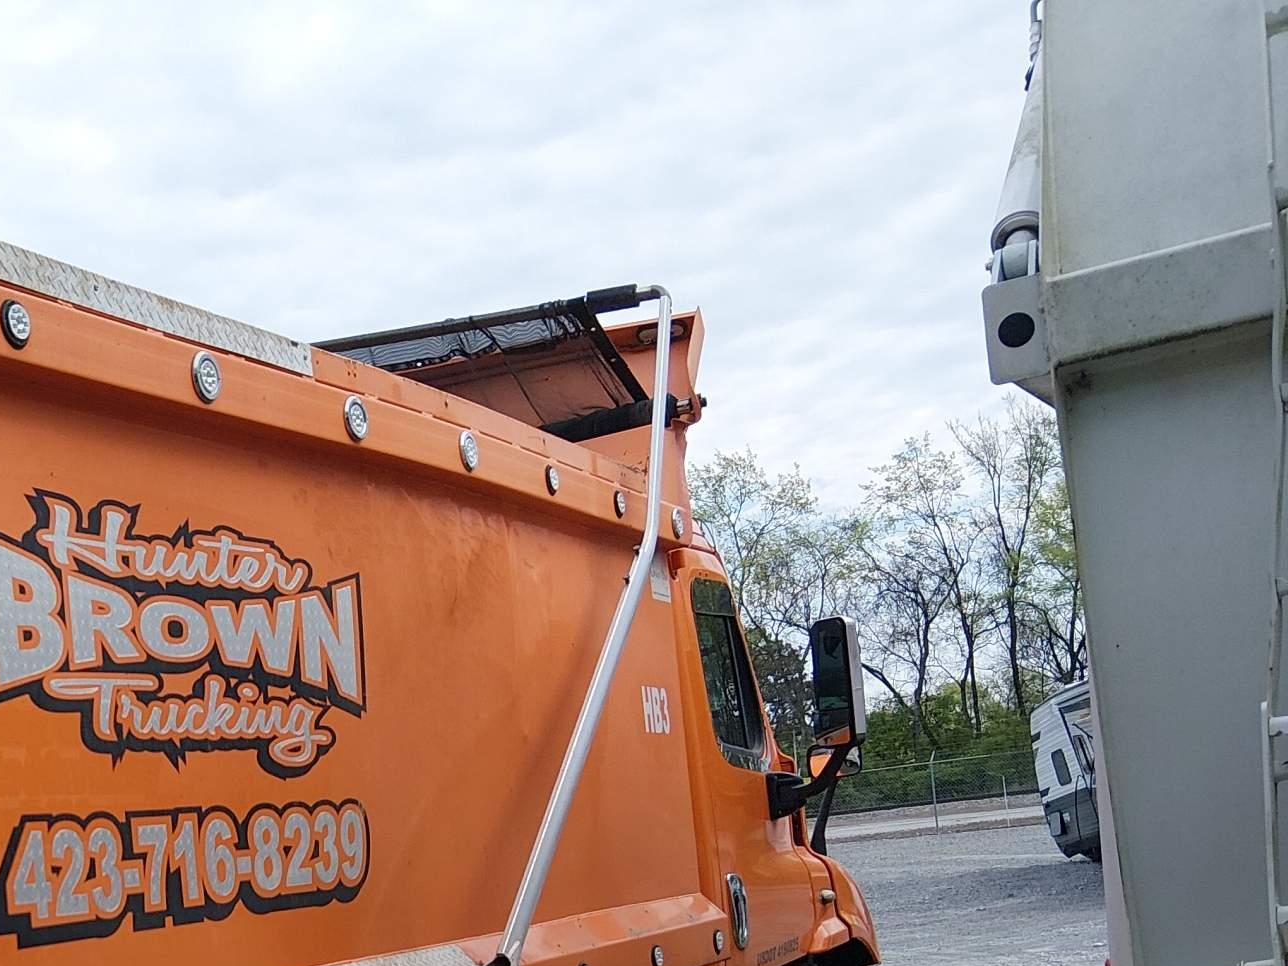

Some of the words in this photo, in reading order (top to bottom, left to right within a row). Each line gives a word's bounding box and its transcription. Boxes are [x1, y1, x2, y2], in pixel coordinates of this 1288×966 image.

[40, 502, 310, 593] Hunter
[44, 676, 332, 766] Trucking
[641, 685, 671, 735] HB3
[10, 806, 368, 922] 423-716-8239
